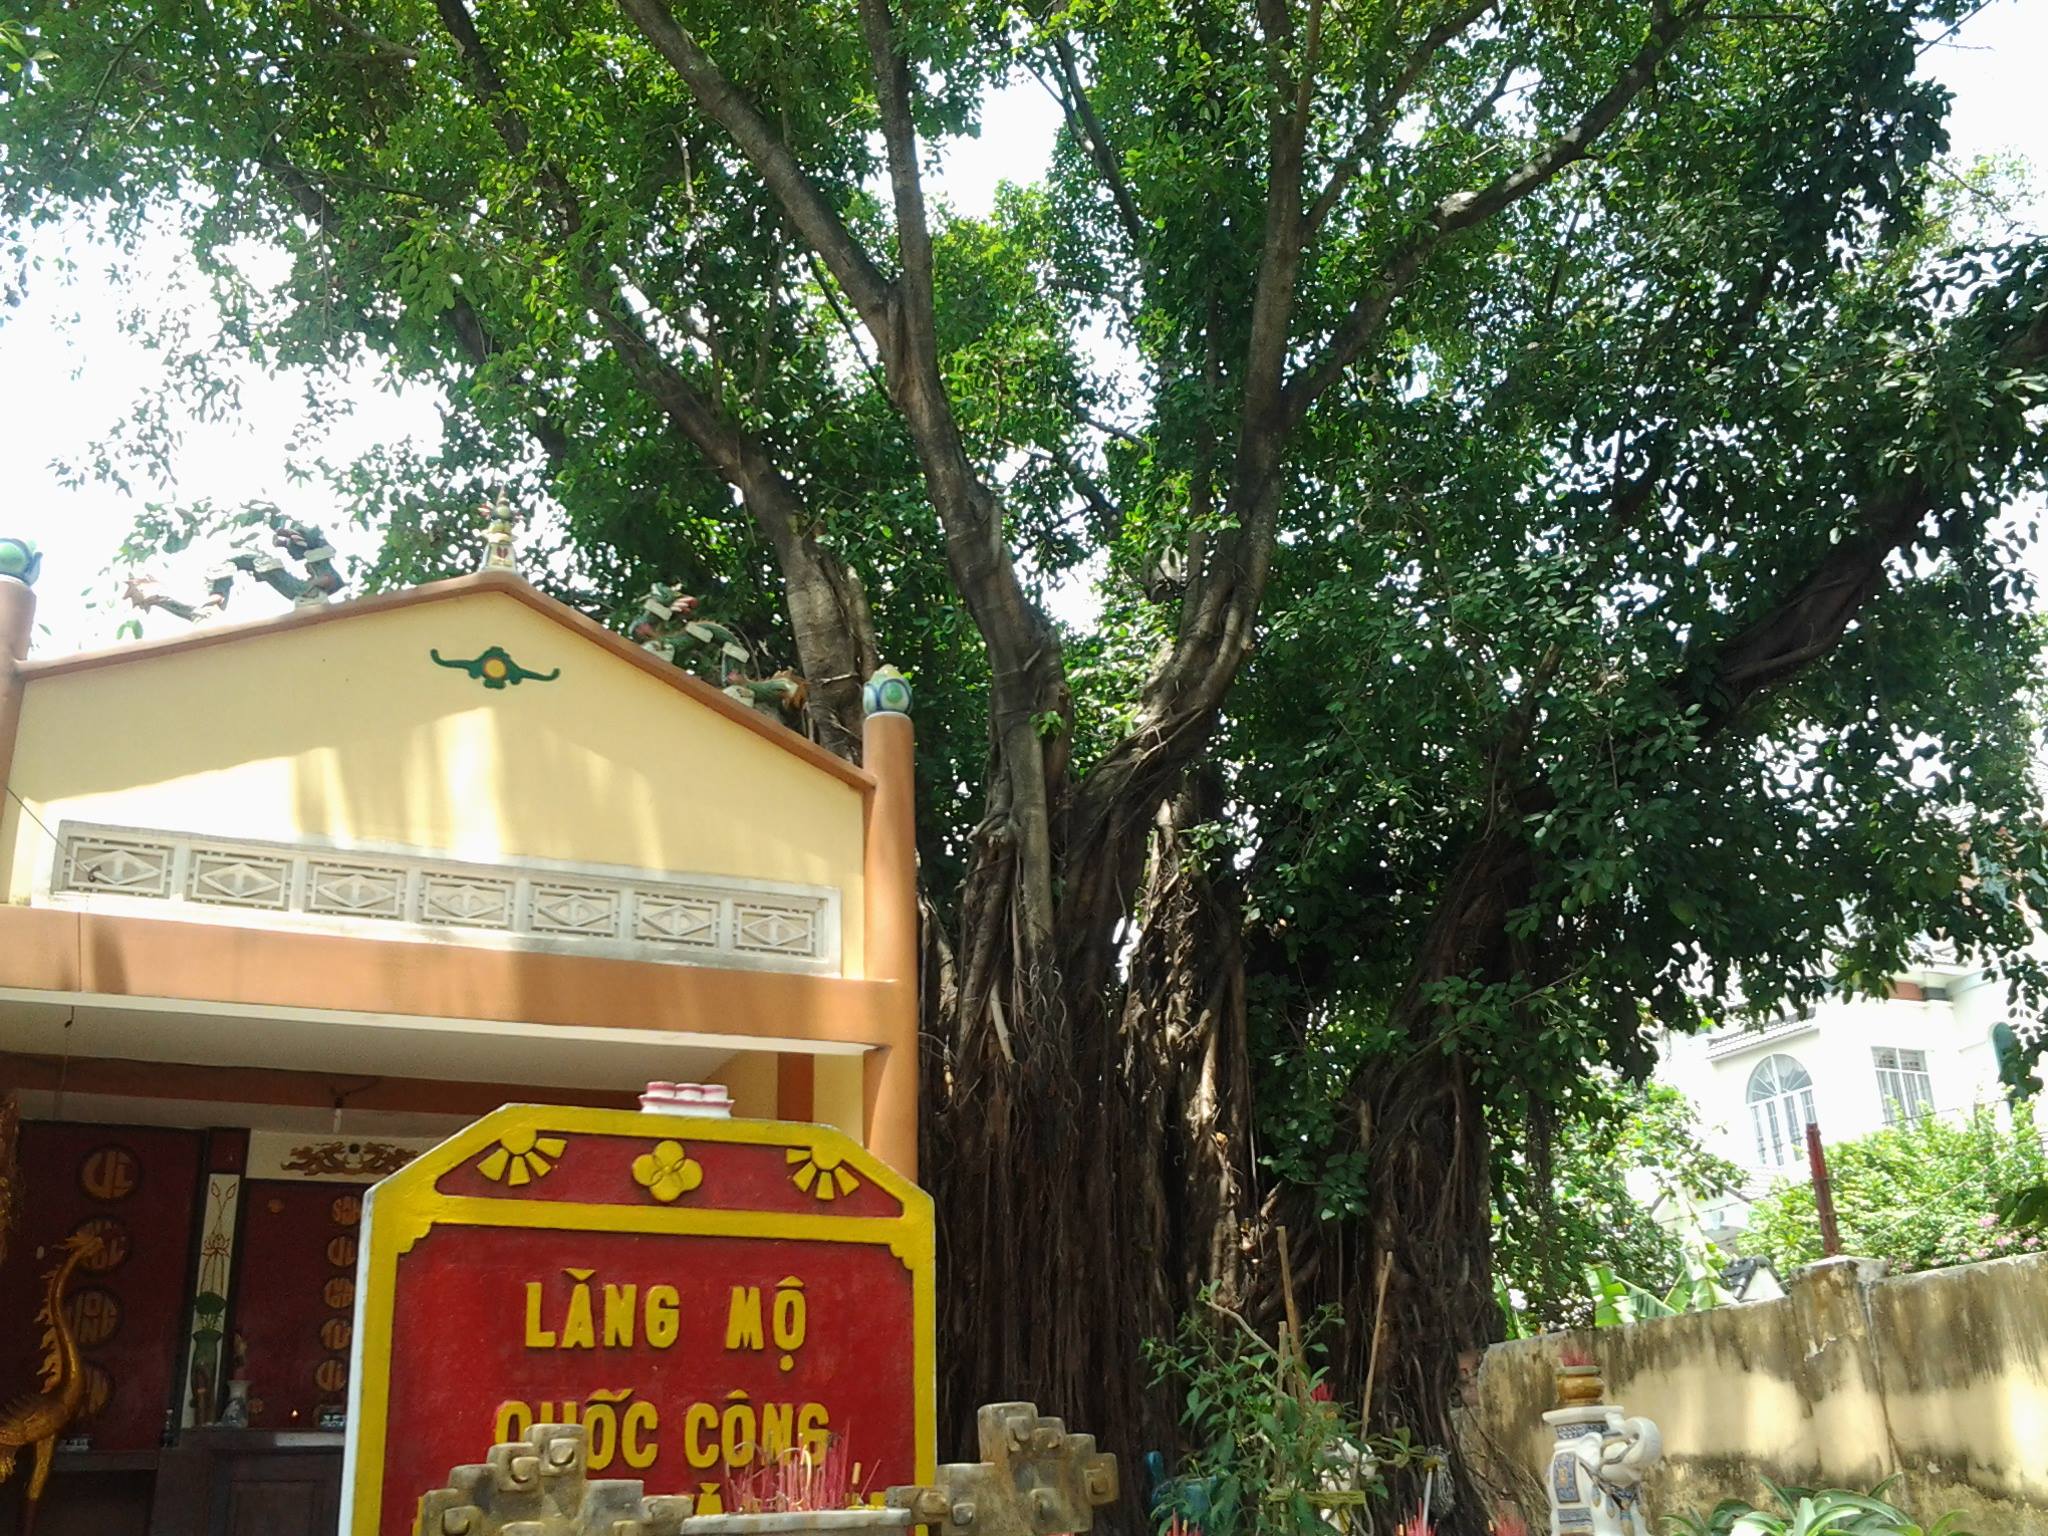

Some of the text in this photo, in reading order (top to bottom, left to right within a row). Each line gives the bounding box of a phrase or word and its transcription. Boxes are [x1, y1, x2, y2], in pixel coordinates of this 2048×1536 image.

[525, 1267, 807, 1373] LĂNG MỘ
[685, 1389, 830, 1468] CÔNG
